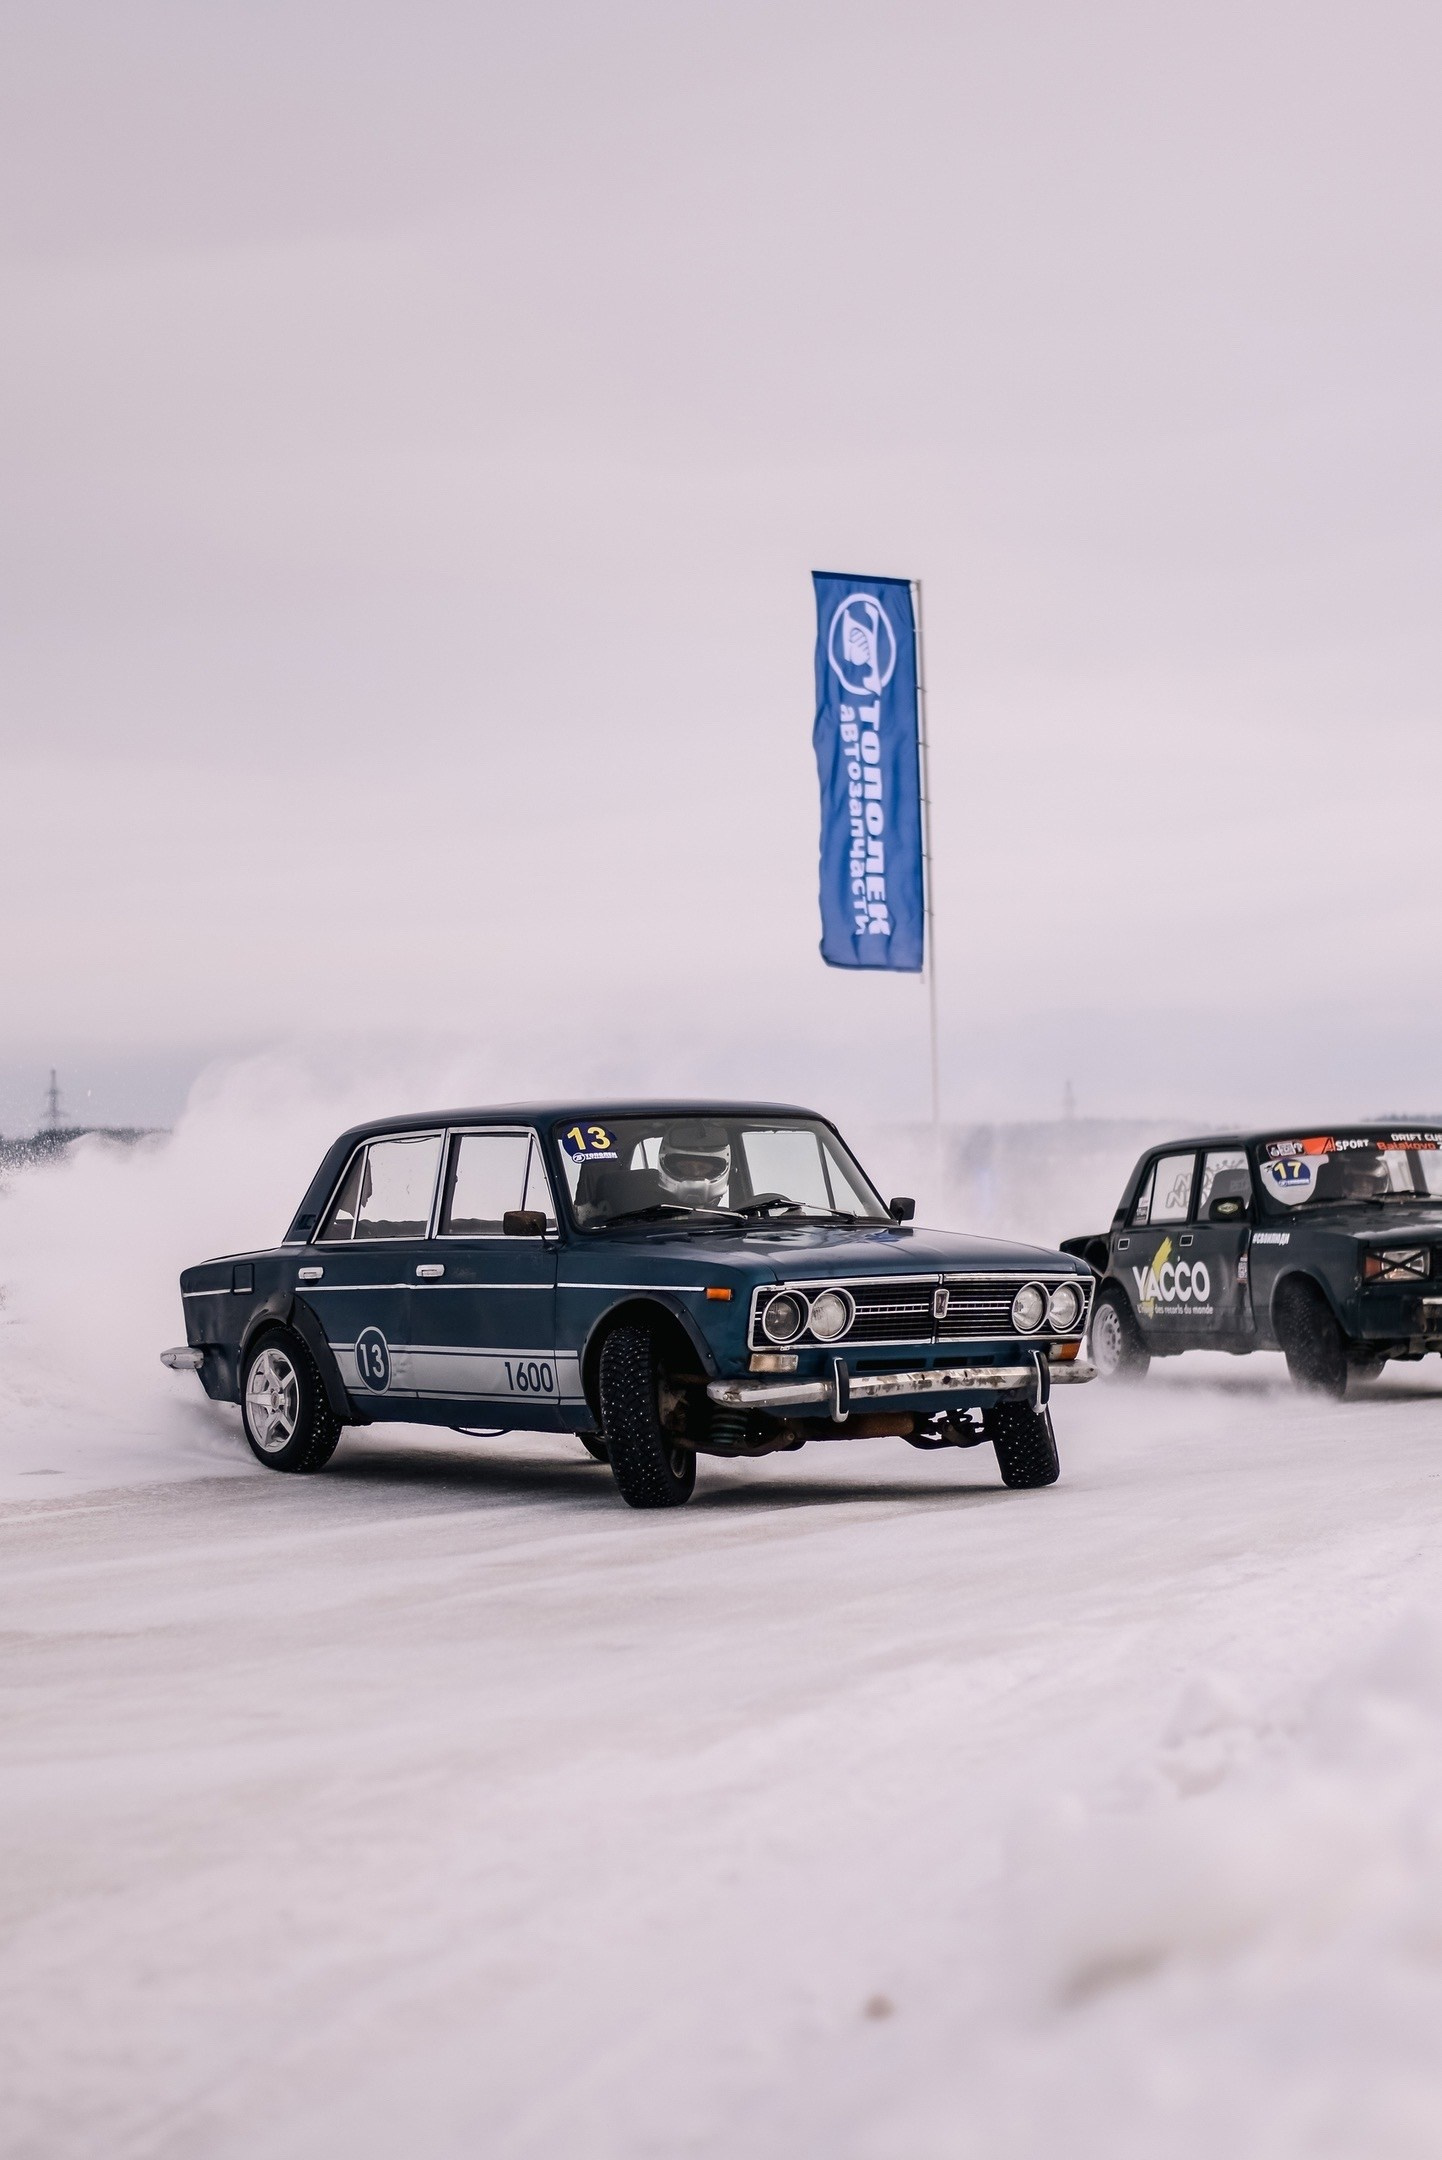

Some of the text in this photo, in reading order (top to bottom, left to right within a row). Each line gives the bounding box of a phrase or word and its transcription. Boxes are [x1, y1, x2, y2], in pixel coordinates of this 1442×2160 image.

[858, 700, 890, 936] ТОПОЛЕК
[566, 1126, 611, 1150] 13
[1335, 1139, 1369, 1151] SPORT
[1376, 1141, 1436, 1150] Balakovo
[1390, 1133, 1421, 1141] DRIFT
[1273, 1161, 1301, 1180] 17
[1132, 1261, 1210, 1302] YACCO
[360, 1343, 385, 1378] 13
[505, 1362, 553, 1392] 1600
